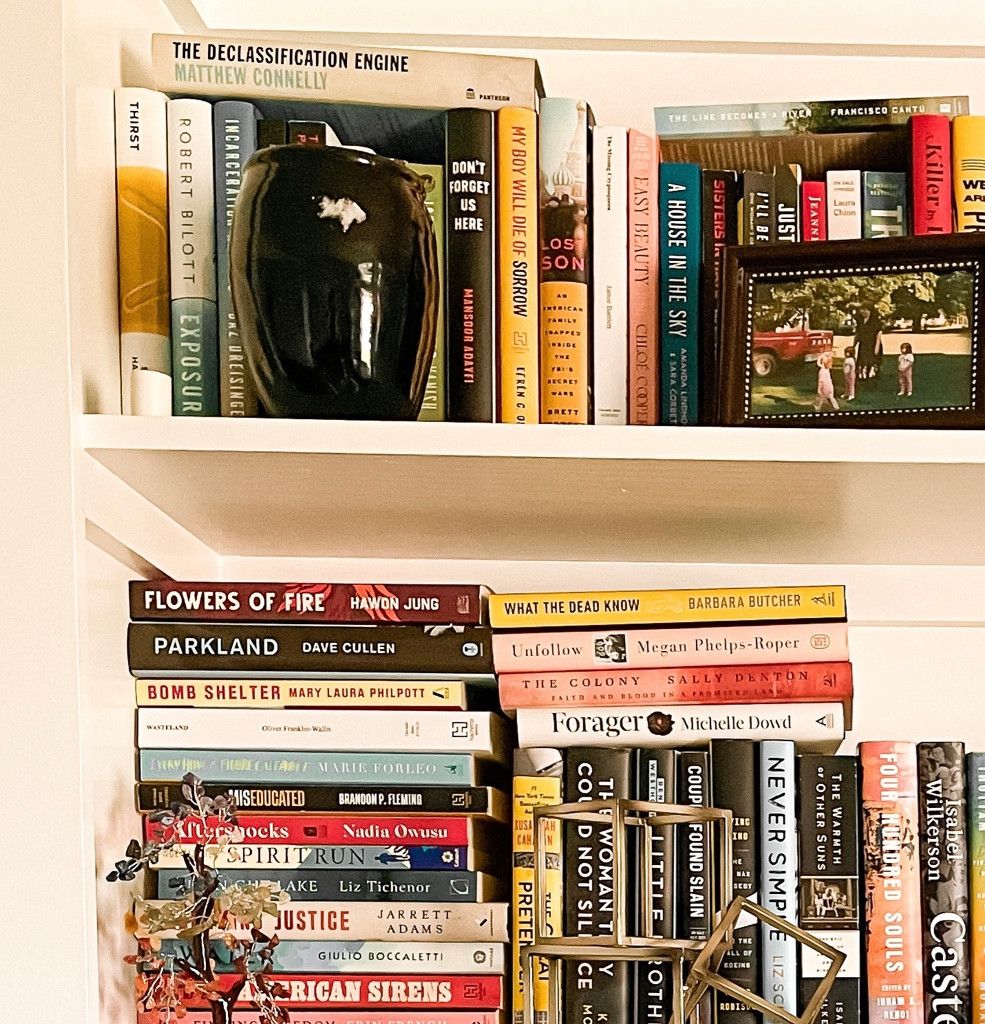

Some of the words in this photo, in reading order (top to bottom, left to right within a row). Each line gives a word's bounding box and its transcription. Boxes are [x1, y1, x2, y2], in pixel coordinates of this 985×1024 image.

[173, 42, 201, 59] THE
[207, 43, 348, 68] DECLASSIFICATION
[355, 53, 409, 72] ENGINE
[830, 106, 888, 116] FRANCISCO
[129, 102, 139, 151] THIRST
[179, 118, 193, 199] ROBERT
[452, 161, 486, 176] DON'T
[450, 179, 489, 195] FORGET
[668, 184, 676, 193] A
[460, 199, 476, 213] US
[454, 216, 483, 232] HERE
[668, 200, 686, 248] HOUSE
[180, 209, 195, 284] BILOTT
[669, 255, 686, 269] IN
[668, 272, 687, 303] THE
[463, 288, 474, 344] MANSOOR
[669, 310, 687, 338] SKY
[464, 348, 474, 384] ADAYFI
[145, 591, 240, 611] FLOWERS
[249, 592, 275, 611] OF
[285, 592, 325, 612] FIRE
[504, 601, 539, 615] WHAT
[543, 601, 565, 614] THE
[568, 600, 600, 613] DEAD
[604, 599, 640, 612] KNOW
[688, 596, 744, 610] BARBARA
[749, 594, 801, 608] BUTCHER
[154, 638, 279, 656] PARKLAND
[512, 644, 582, 657] Unfollow
[638, 640, 687, 656] Megan
[695, 638, 800, 654] Phelps-Roper
[147, 685, 196, 700] BOMB
[204, 686, 281, 700] SHELTER
[288, 688, 322, 698] MARY
[327, 688, 365, 699] LAURA
[370, 688, 425, 699] PHILPOTT
[551, 712, 643, 737] Forager
[681, 716, 744, 731] Michelle
[749, 716, 792, 729] Dowd
[343, 824, 389, 838] Nadia
[394, 825, 448, 839] Owusu
[924, 778, 941, 882] Wilkerson
[946, 800, 962, 860] Isabel
[339, 880, 361, 893] Liz
[366, 880, 431, 893] Tichenor
[318, 951, 361, 961] GIULIO
[368, 952, 443, 961] BOCCALETTI
[369, 982, 452, 1002] SIRENS
